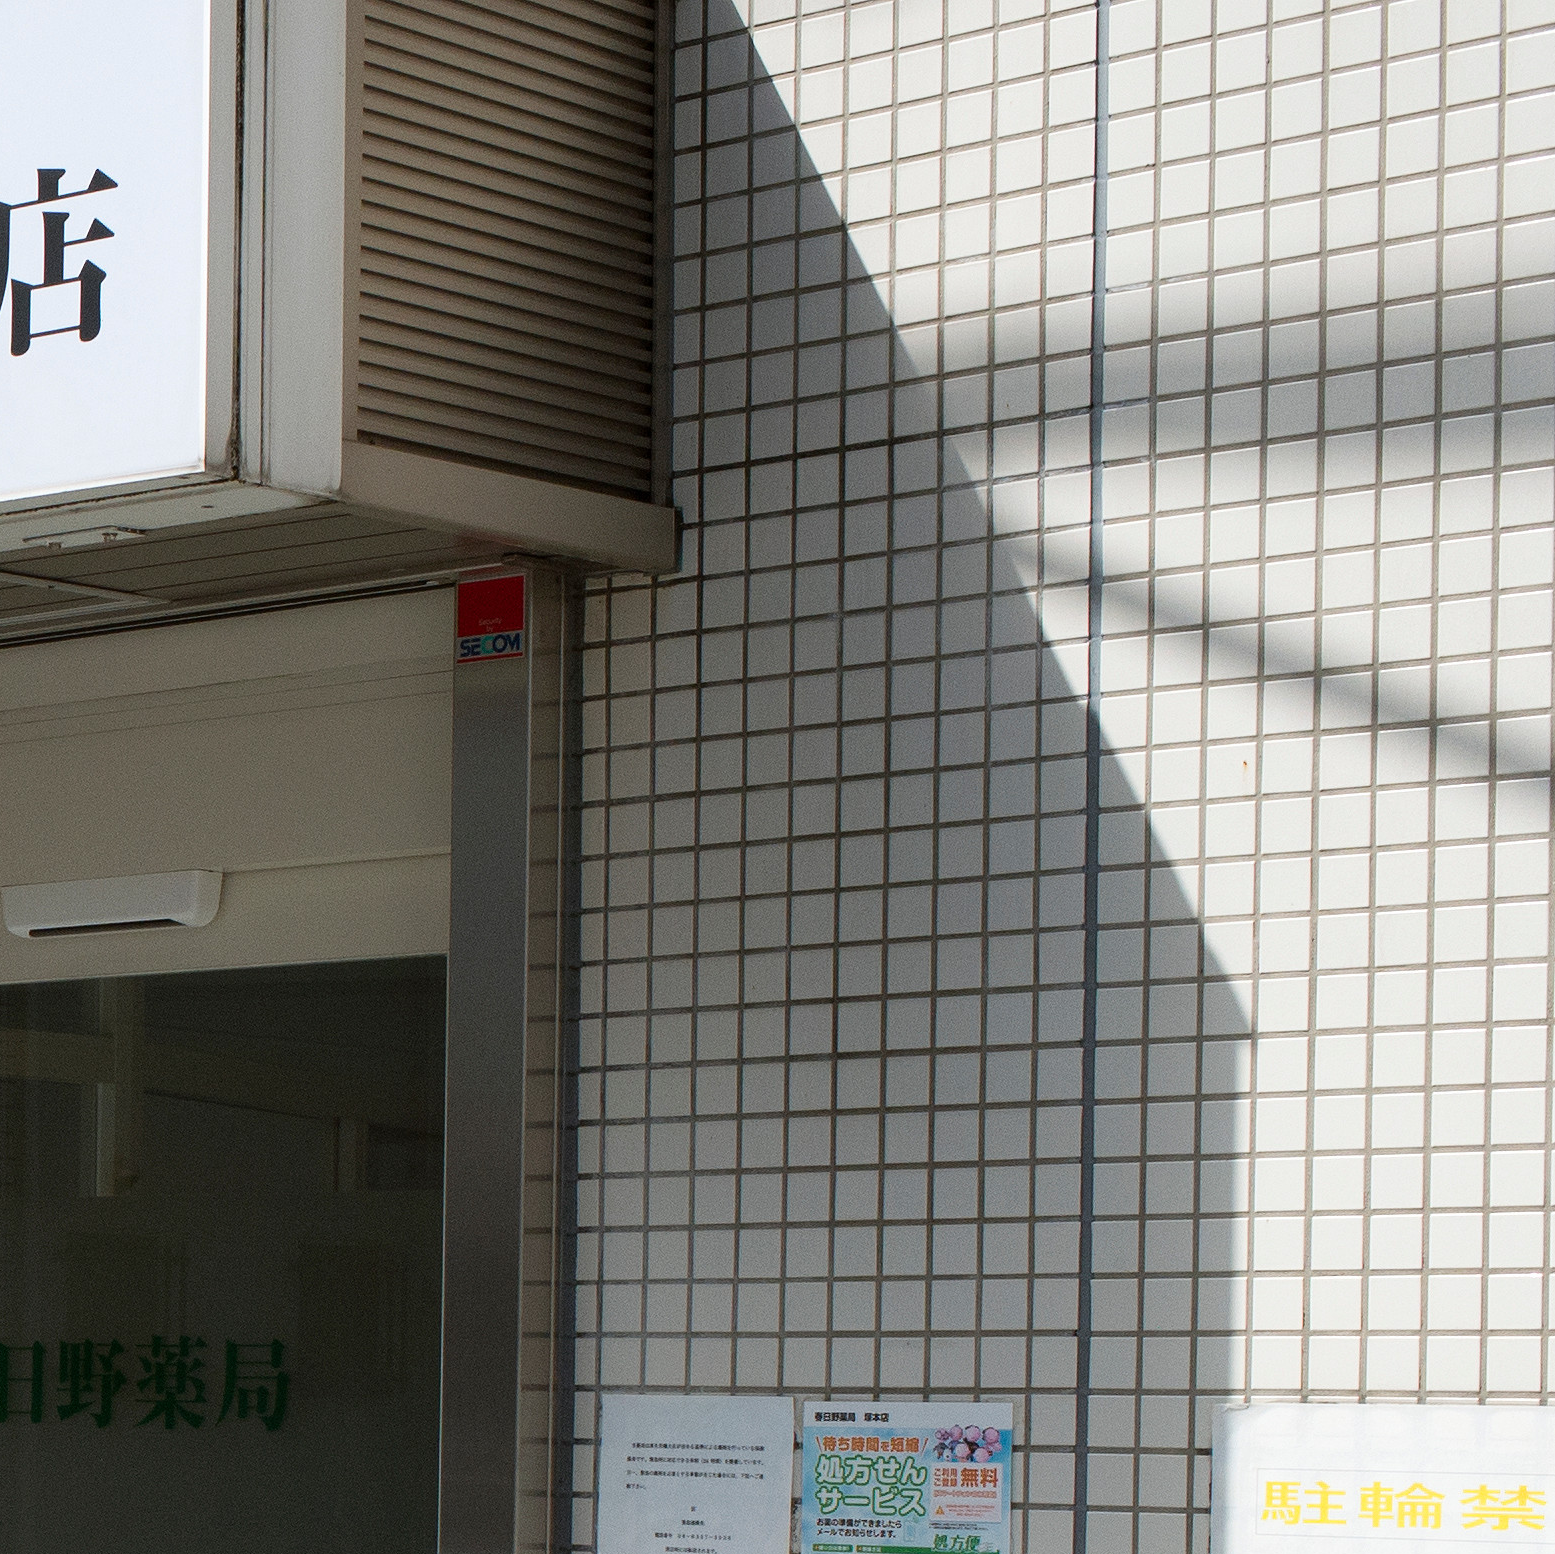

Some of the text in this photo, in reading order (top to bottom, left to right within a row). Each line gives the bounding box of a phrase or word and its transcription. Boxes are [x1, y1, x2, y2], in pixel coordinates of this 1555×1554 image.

[459, 632, 522, 658] SECOM
[814, 1411, 889, 1423] 春日野薬局 塚本店
[823, 1436, 920, 1454] 待ち時間を短縮
[815, 1453, 928, 1487] 処方せん
[960, 1467, 999, 1488] 無料
[815, 1485, 927, 1517] サービス
[1261, 1480, 1547, 1531] 駐輪禁
[816, 1517, 903, 1530] お薬の準備ができましたら
[816, 1527, 897, 1539] メールでお知らせします。
